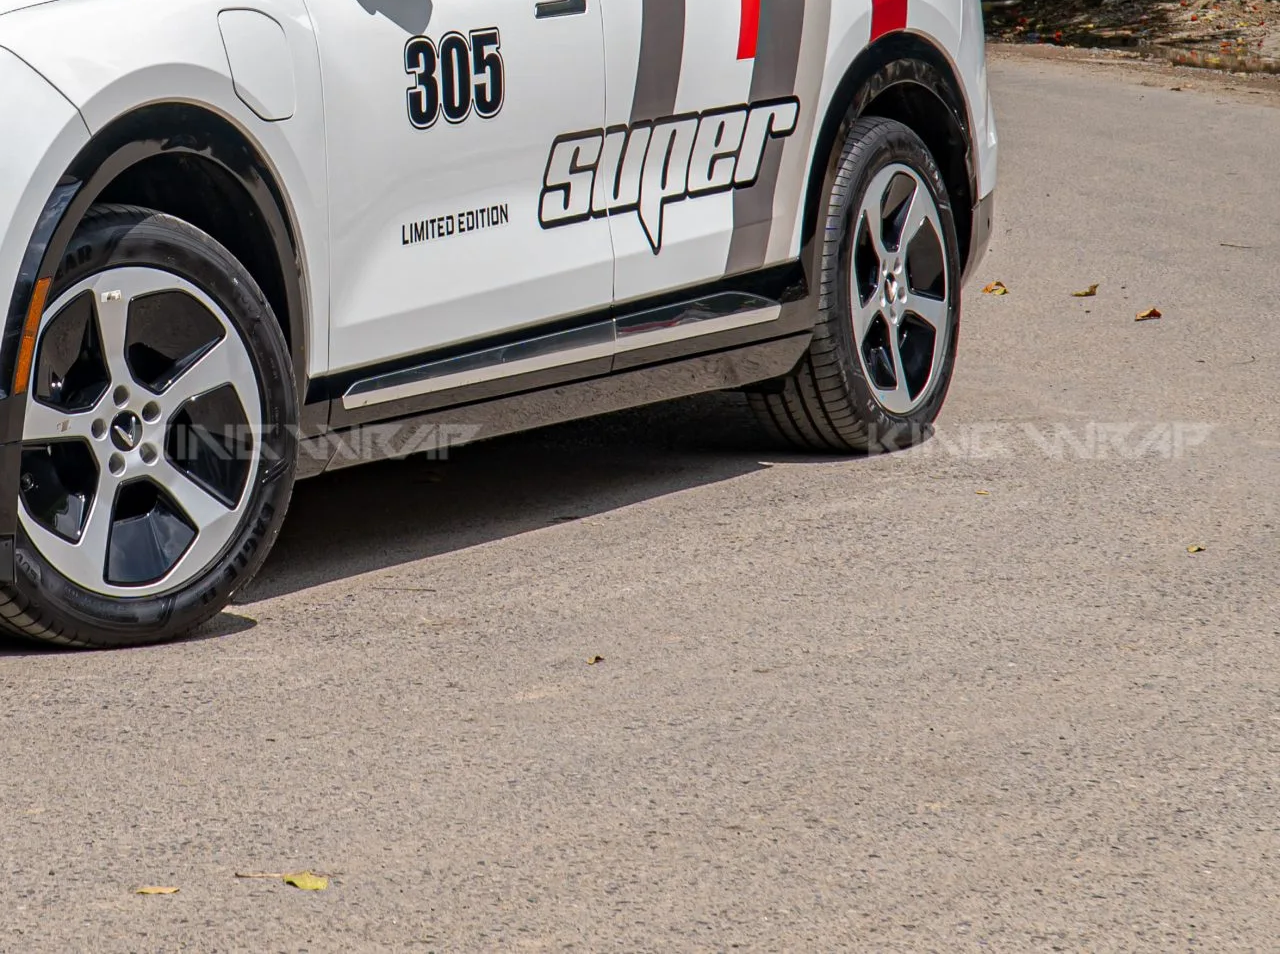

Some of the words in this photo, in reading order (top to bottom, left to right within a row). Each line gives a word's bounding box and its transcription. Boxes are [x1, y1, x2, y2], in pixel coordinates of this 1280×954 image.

[403, 26, 505, 130] 305
[402, 214, 455, 246] LIMITED
[458, 203, 509, 234] EDITION
[537, 95, 801, 256] super
